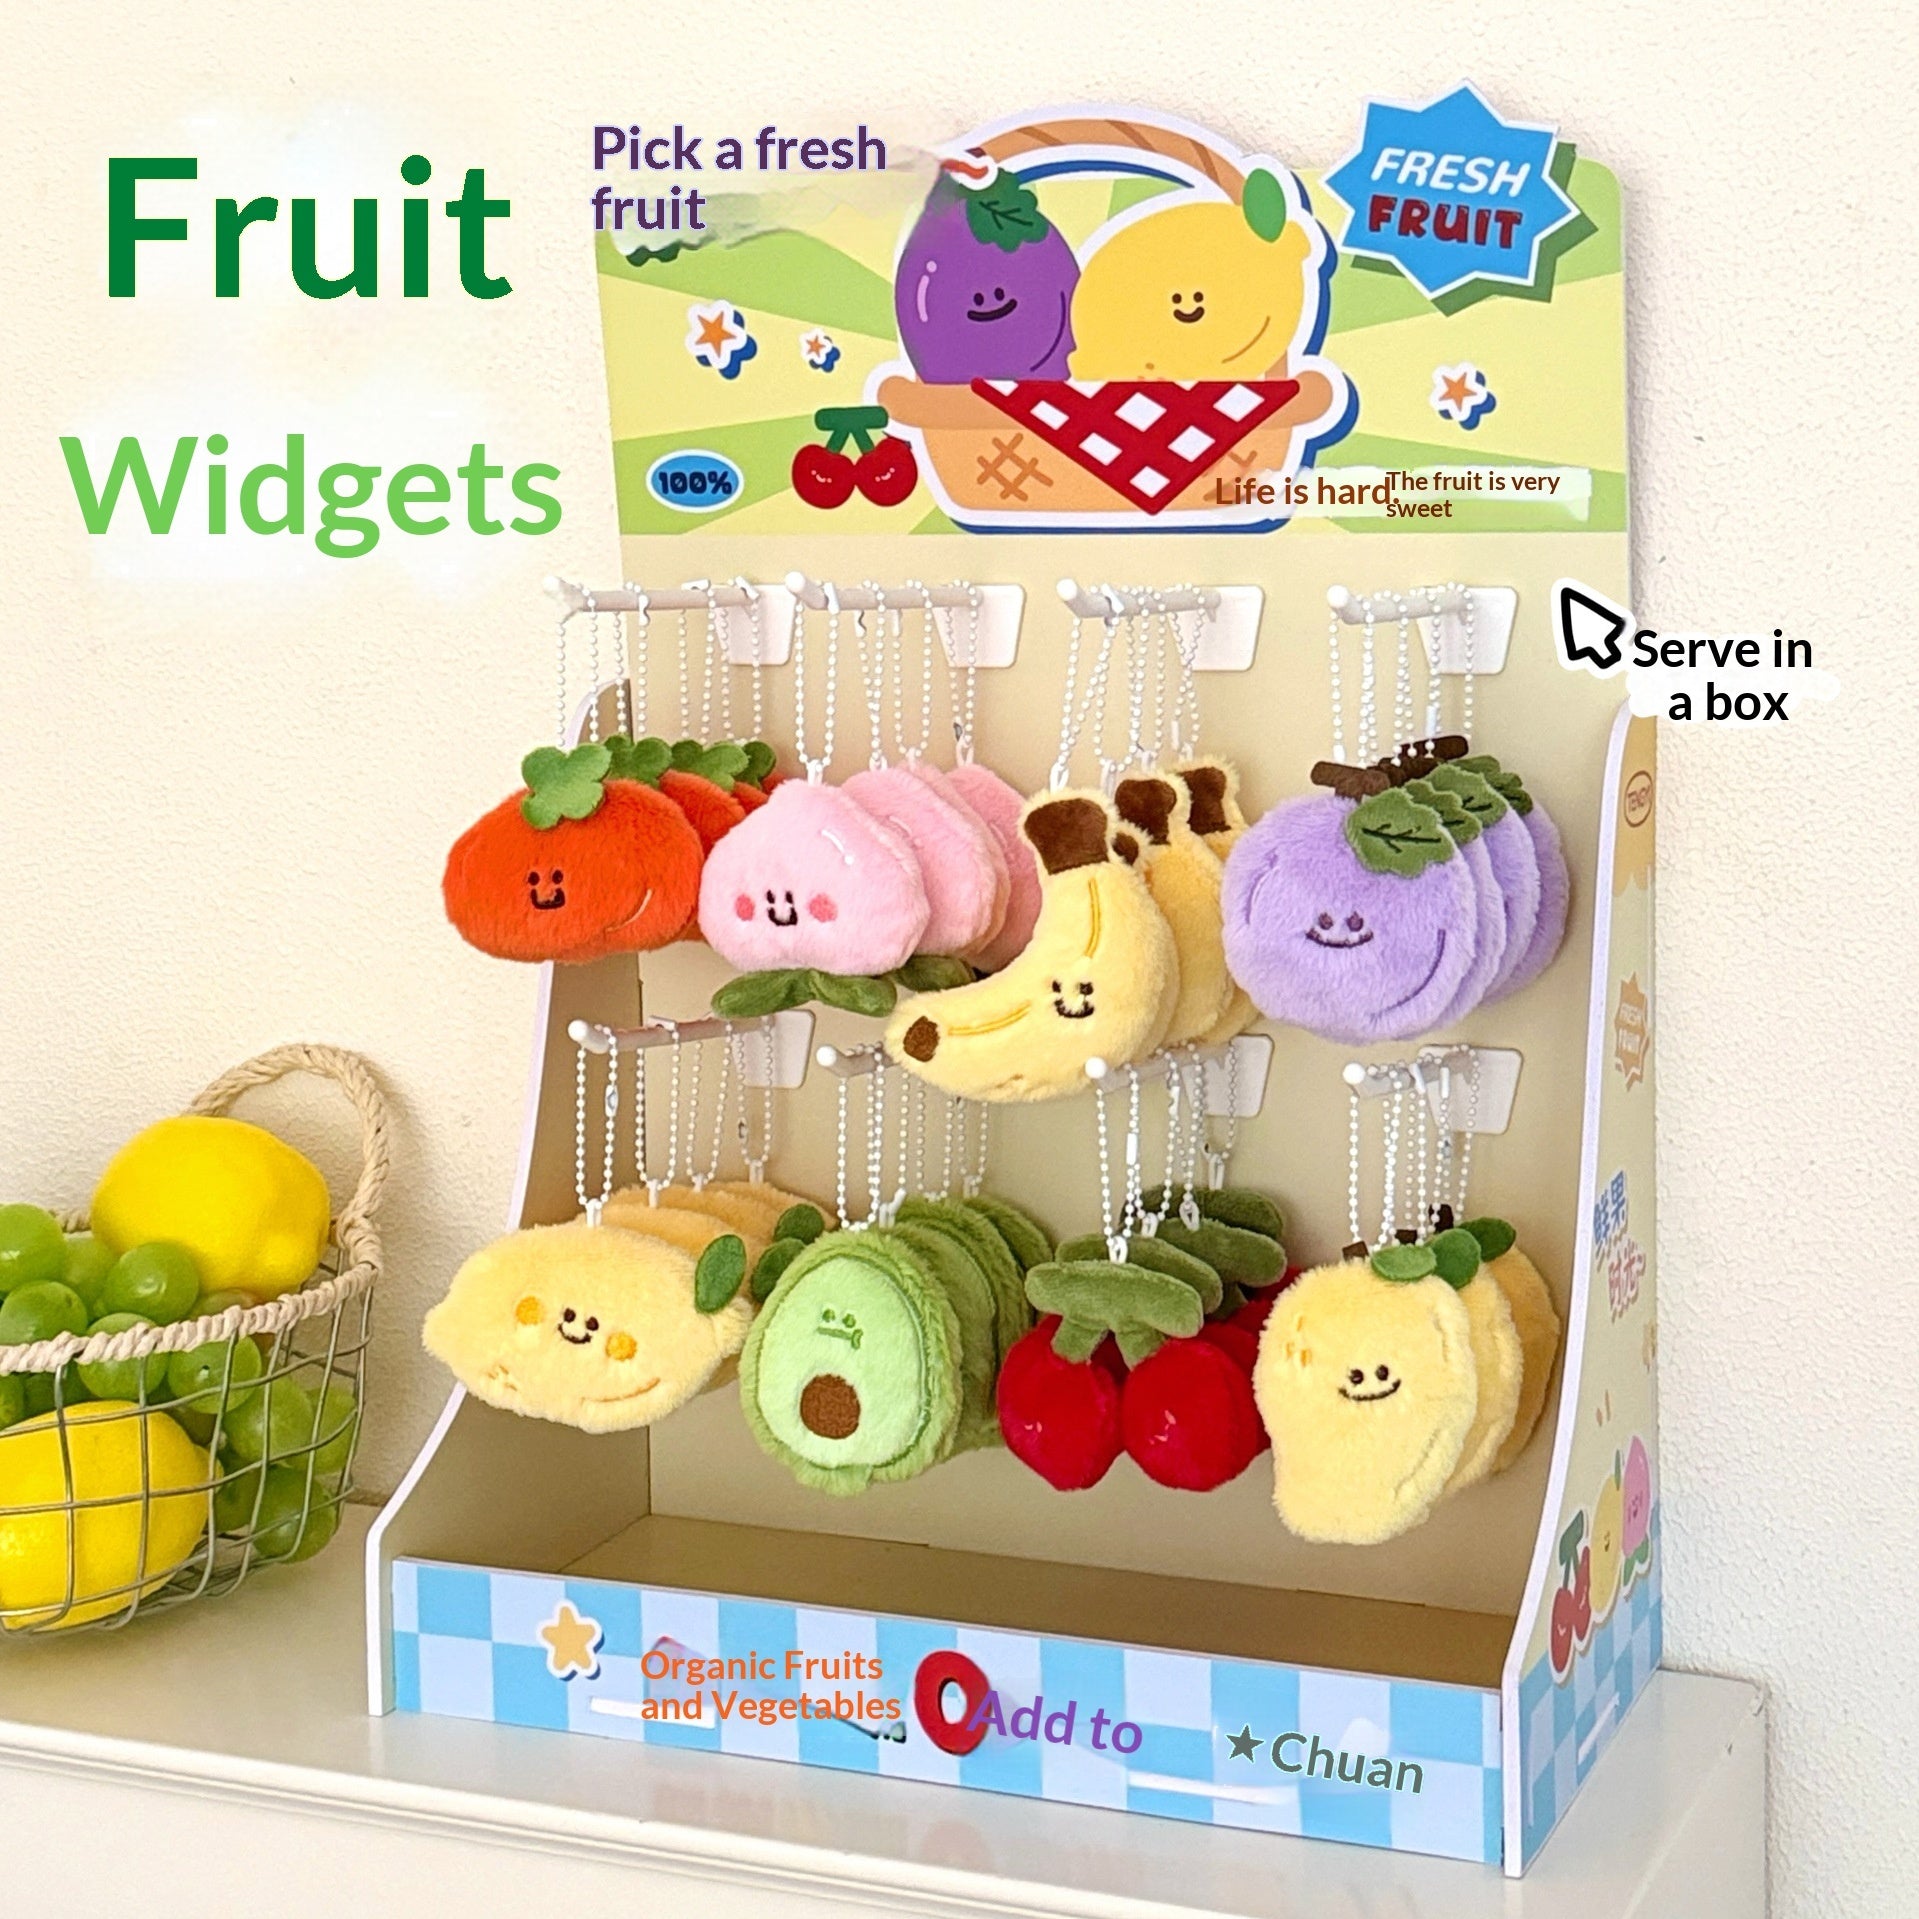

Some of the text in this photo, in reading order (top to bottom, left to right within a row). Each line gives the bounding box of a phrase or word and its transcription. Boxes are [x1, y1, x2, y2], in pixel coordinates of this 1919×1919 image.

[1370, 147, 1531, 198] FRESH
[1368, 195, 1523, 249] FRUIT
[658, 471, 732, 496] 100%
